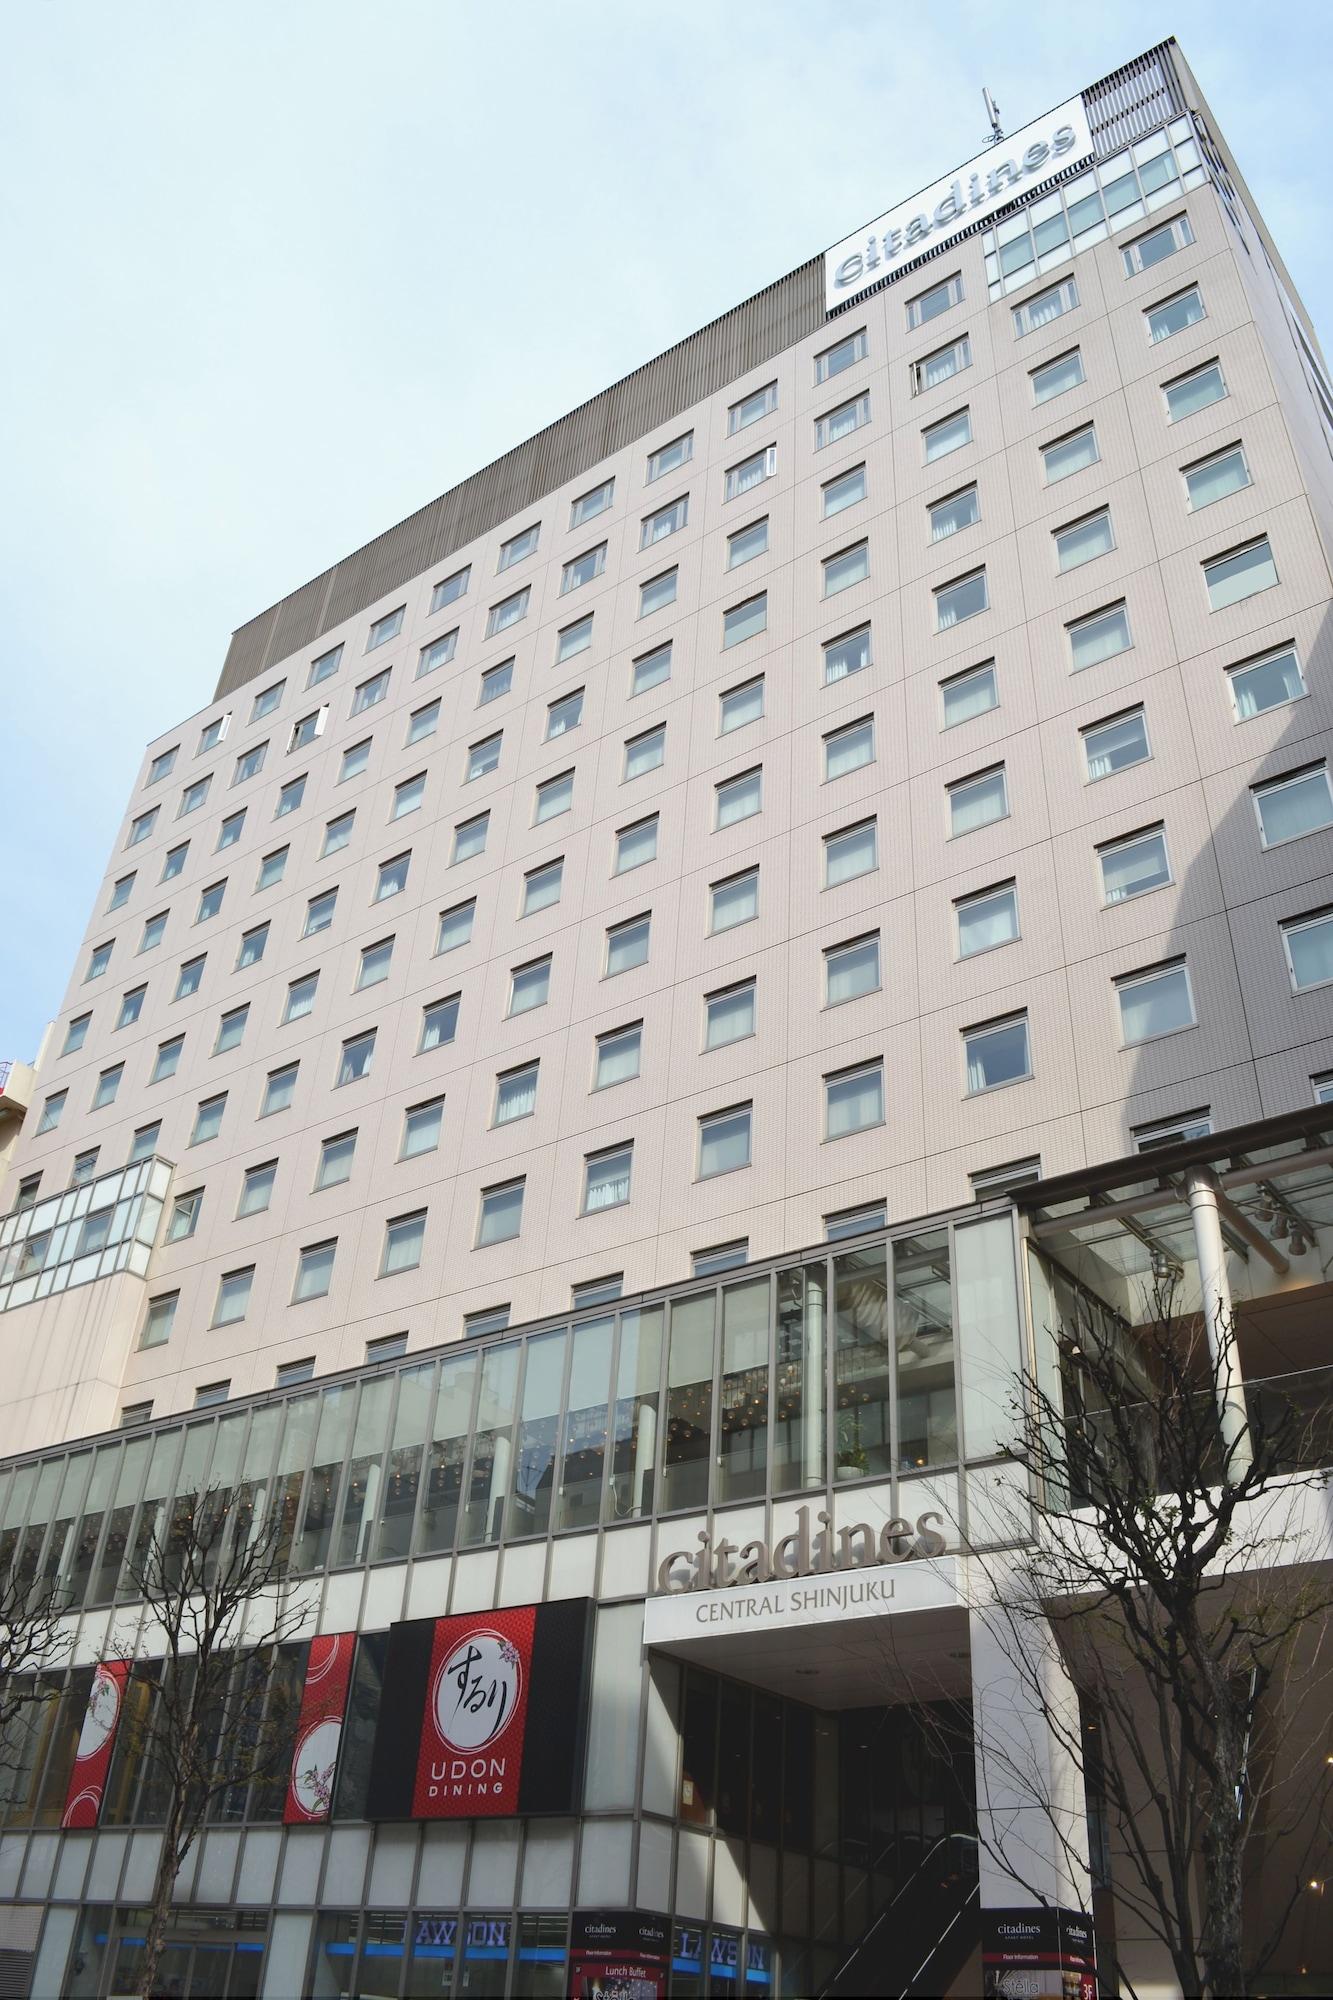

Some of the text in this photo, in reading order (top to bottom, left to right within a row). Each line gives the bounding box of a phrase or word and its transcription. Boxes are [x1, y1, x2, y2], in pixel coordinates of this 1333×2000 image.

[834, 123, 1077, 289] citadines
[658, 1505, 948, 1595] citadines
[696, 1579, 896, 1623] CENTRAL SHINJUKU
[431, 1758, 506, 1781] UDON
[429, 1782, 503, 1797] DINING
[585, 1924, 617, 1934] citadines
[997, 1922, 1041, 1934] citadines
[605, 1966, 646, 1978] Lunch Buffet
